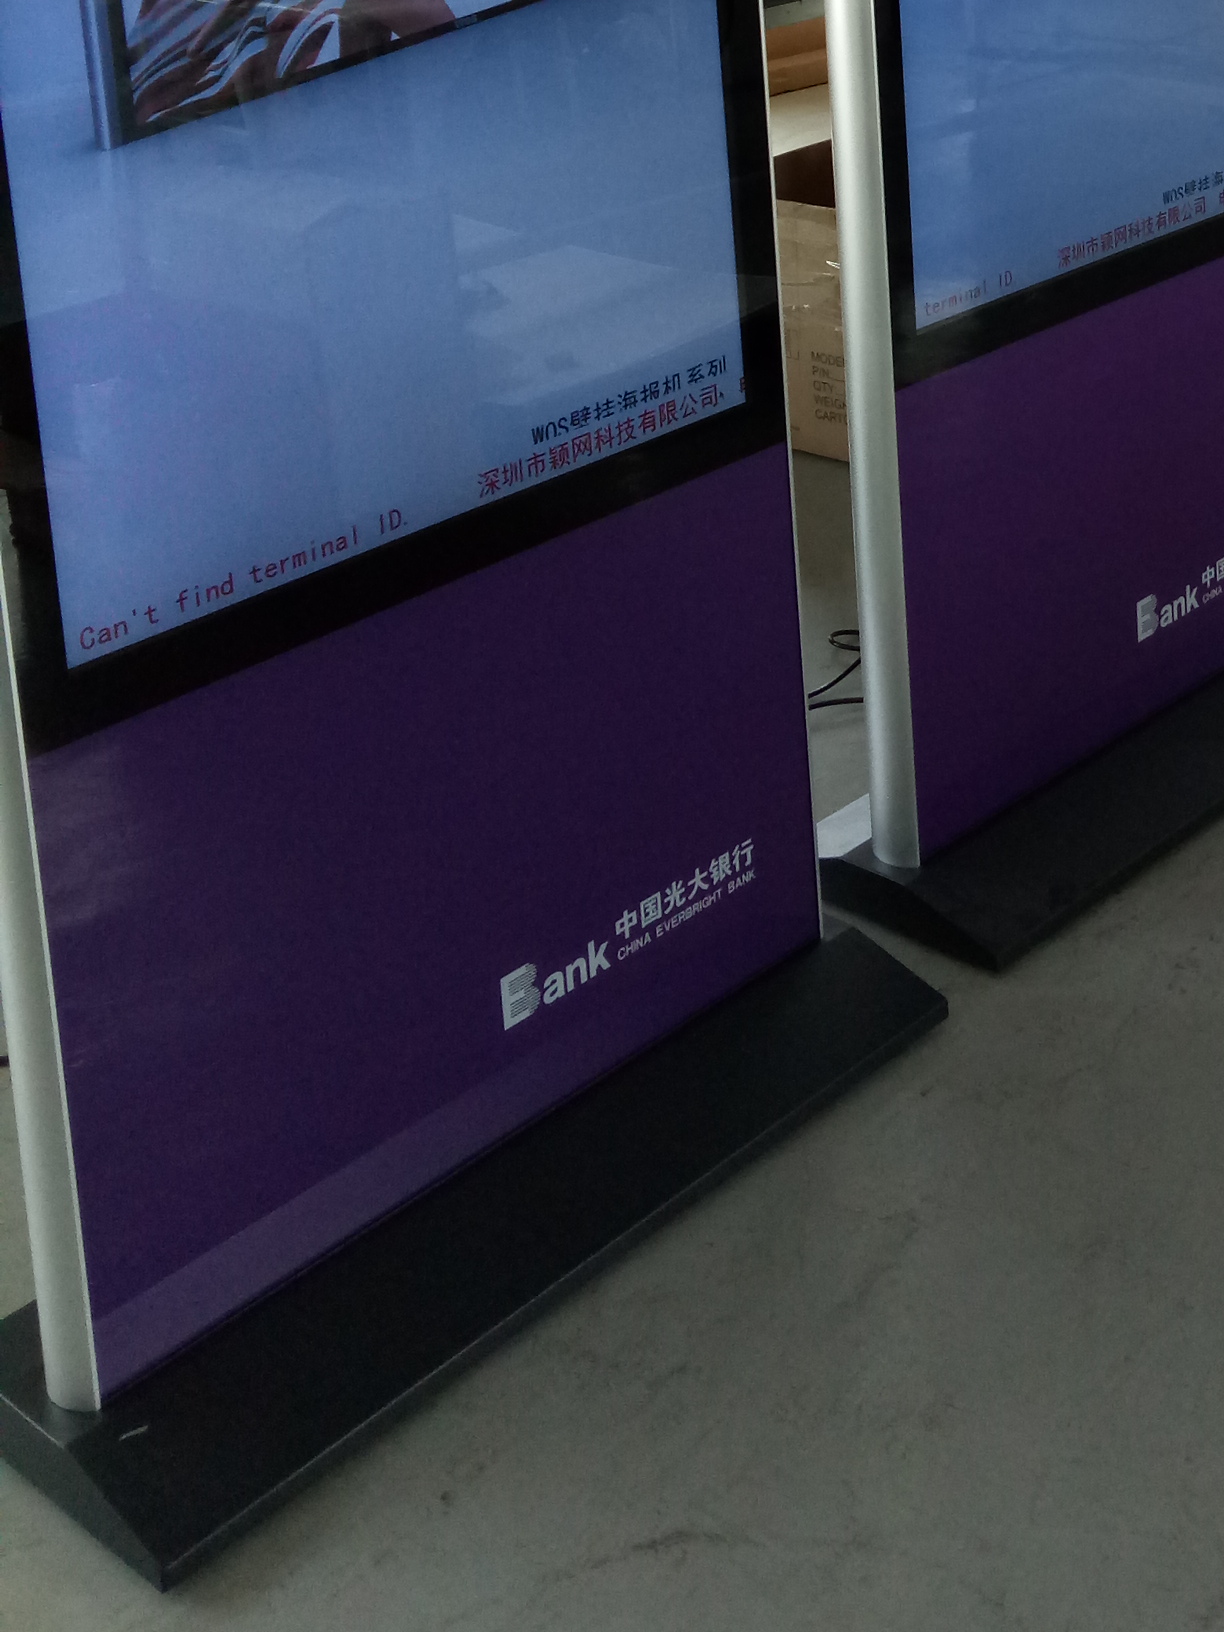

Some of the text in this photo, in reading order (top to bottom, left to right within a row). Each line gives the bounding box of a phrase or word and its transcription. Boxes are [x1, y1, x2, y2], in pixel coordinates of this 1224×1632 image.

[79, 604, 160, 651] Can't
[175, 572, 236, 614] find
[248, 524, 360, 584] terminal
[1136, 584, 1200, 644] Bank
[614, 837, 755, 940] 中国光大银行
[616, 868, 757, 961] CHINA EVERBRIGHT BANK
[499, 939, 612, 1032] Bank
